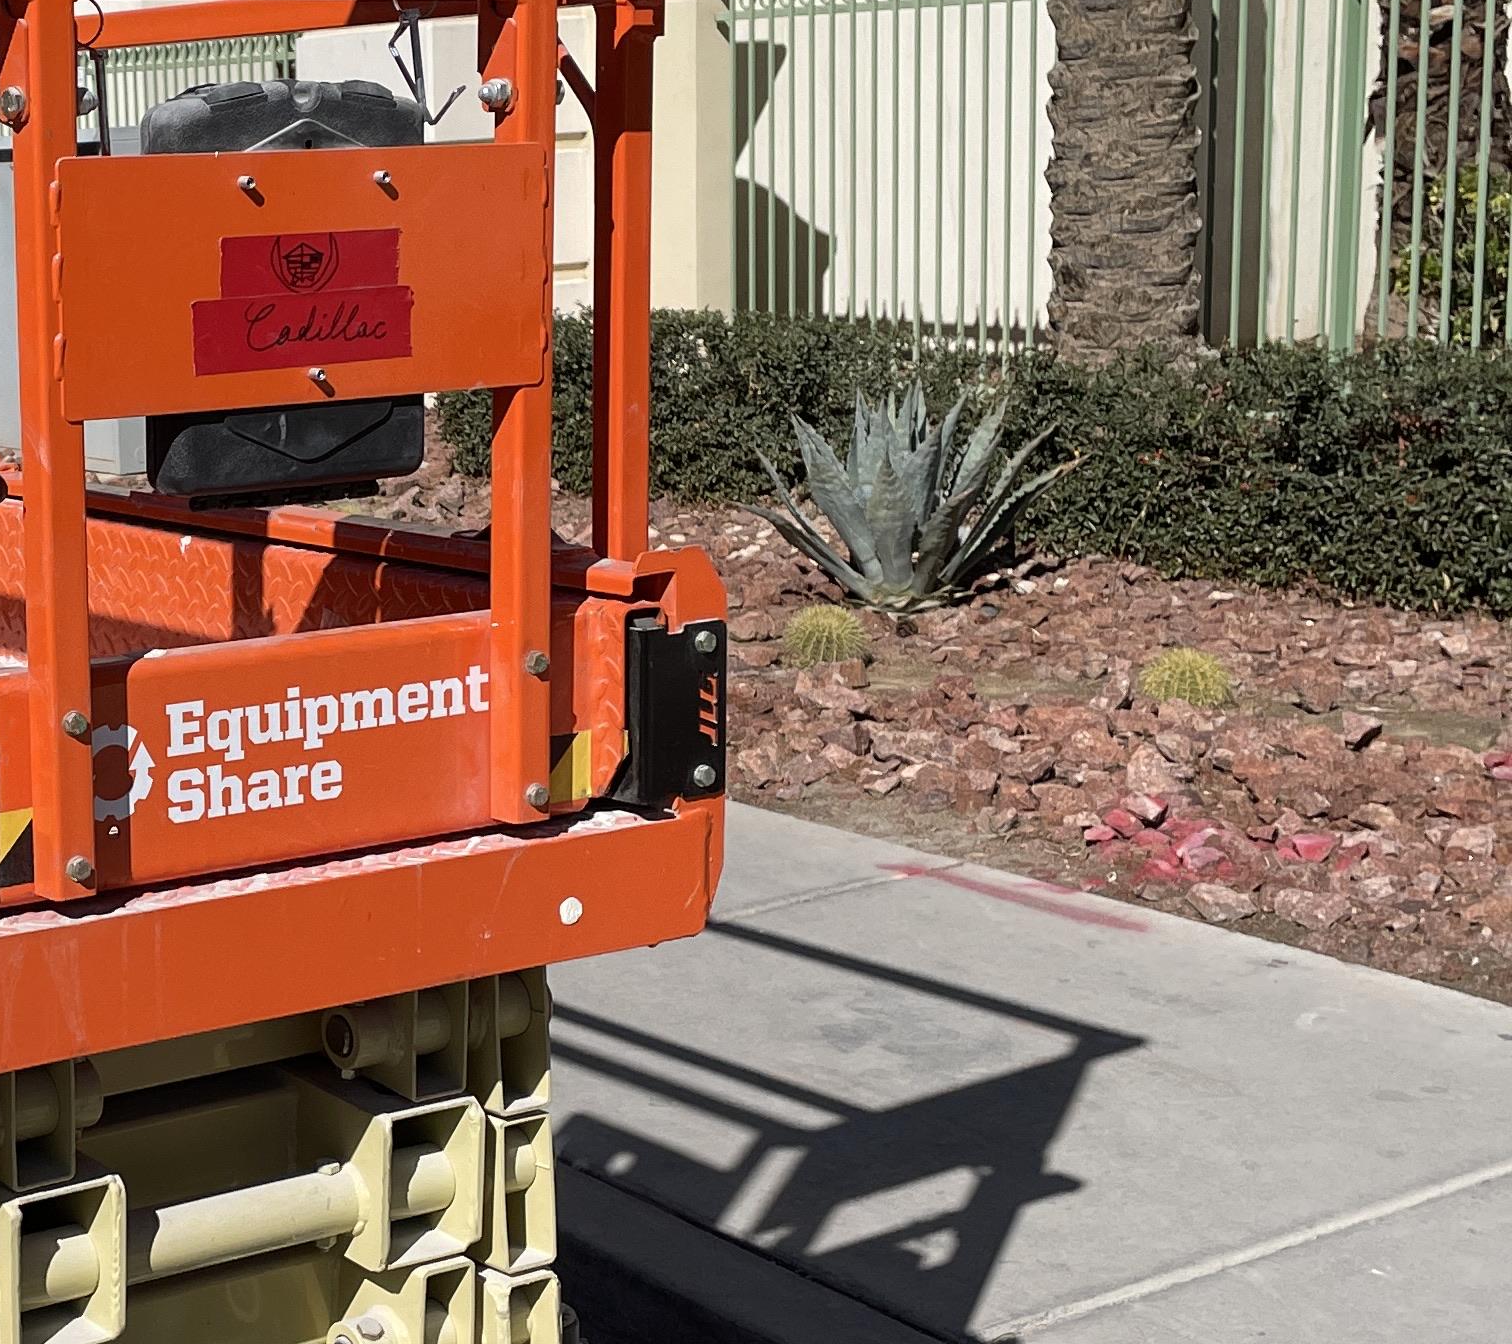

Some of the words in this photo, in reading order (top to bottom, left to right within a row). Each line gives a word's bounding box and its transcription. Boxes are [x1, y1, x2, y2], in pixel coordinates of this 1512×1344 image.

[245, 301, 387, 352] Cadillac
[165, 664, 489, 762] Equipment
[699, 672, 719, 747] JLG
[167, 760, 343, 824] Share
